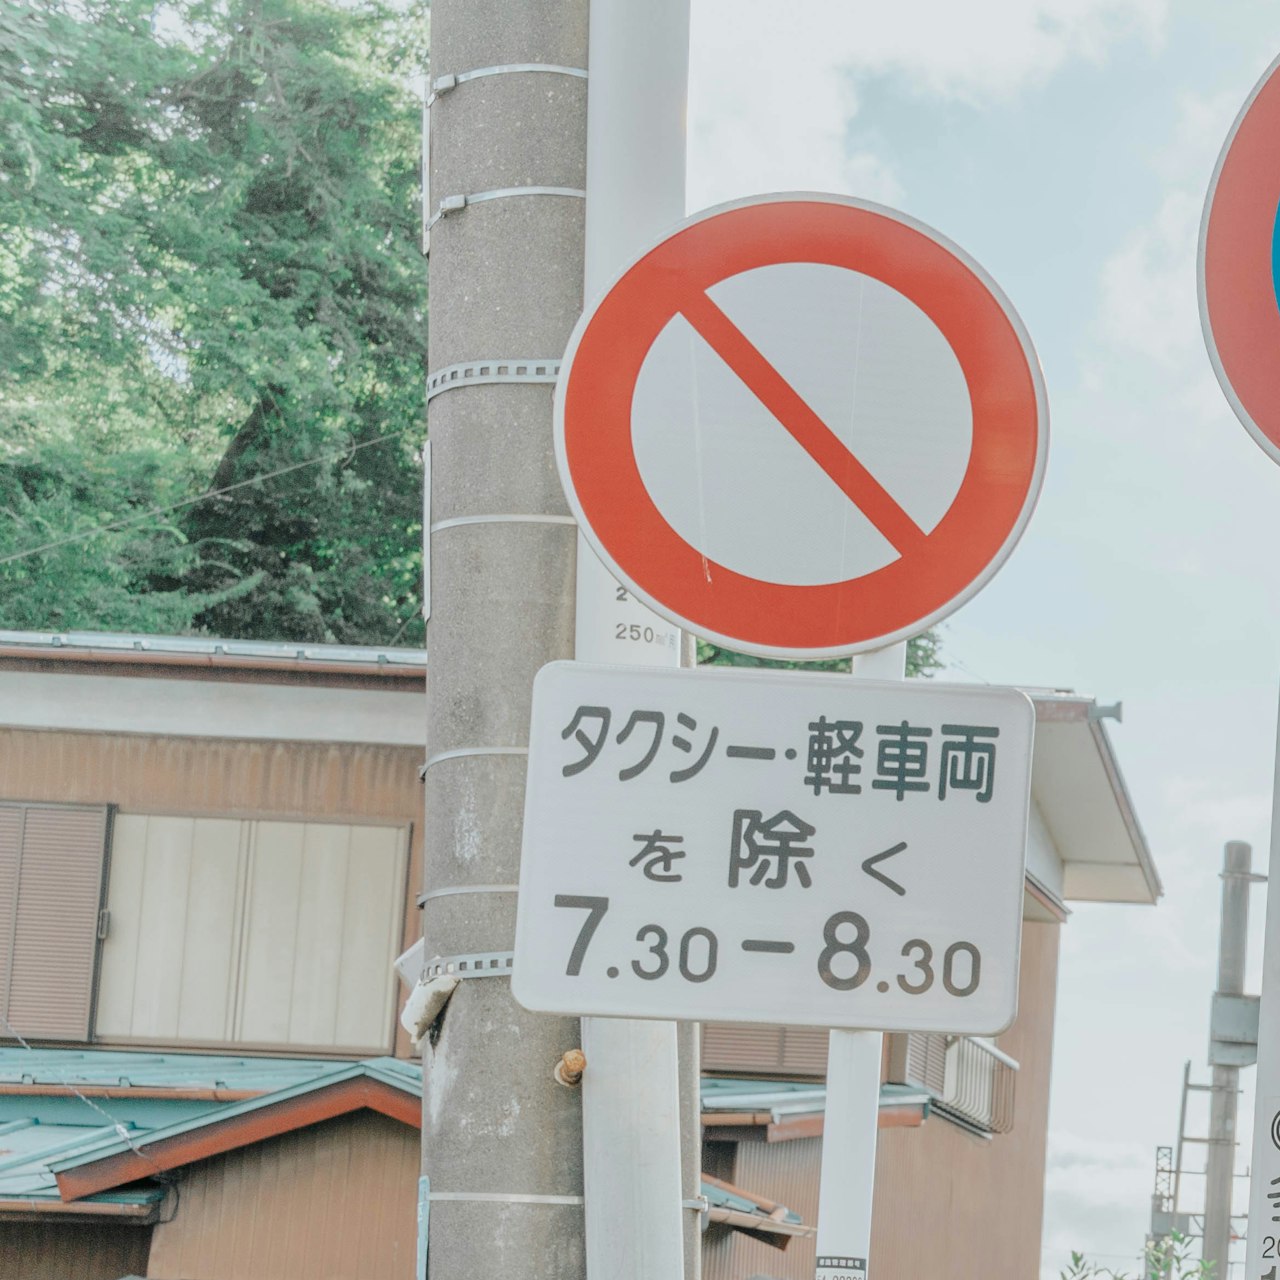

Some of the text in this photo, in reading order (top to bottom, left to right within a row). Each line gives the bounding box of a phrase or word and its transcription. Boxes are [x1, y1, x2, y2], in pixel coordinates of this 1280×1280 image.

[561, 705, 1001, 804] タクシー・軽車両
